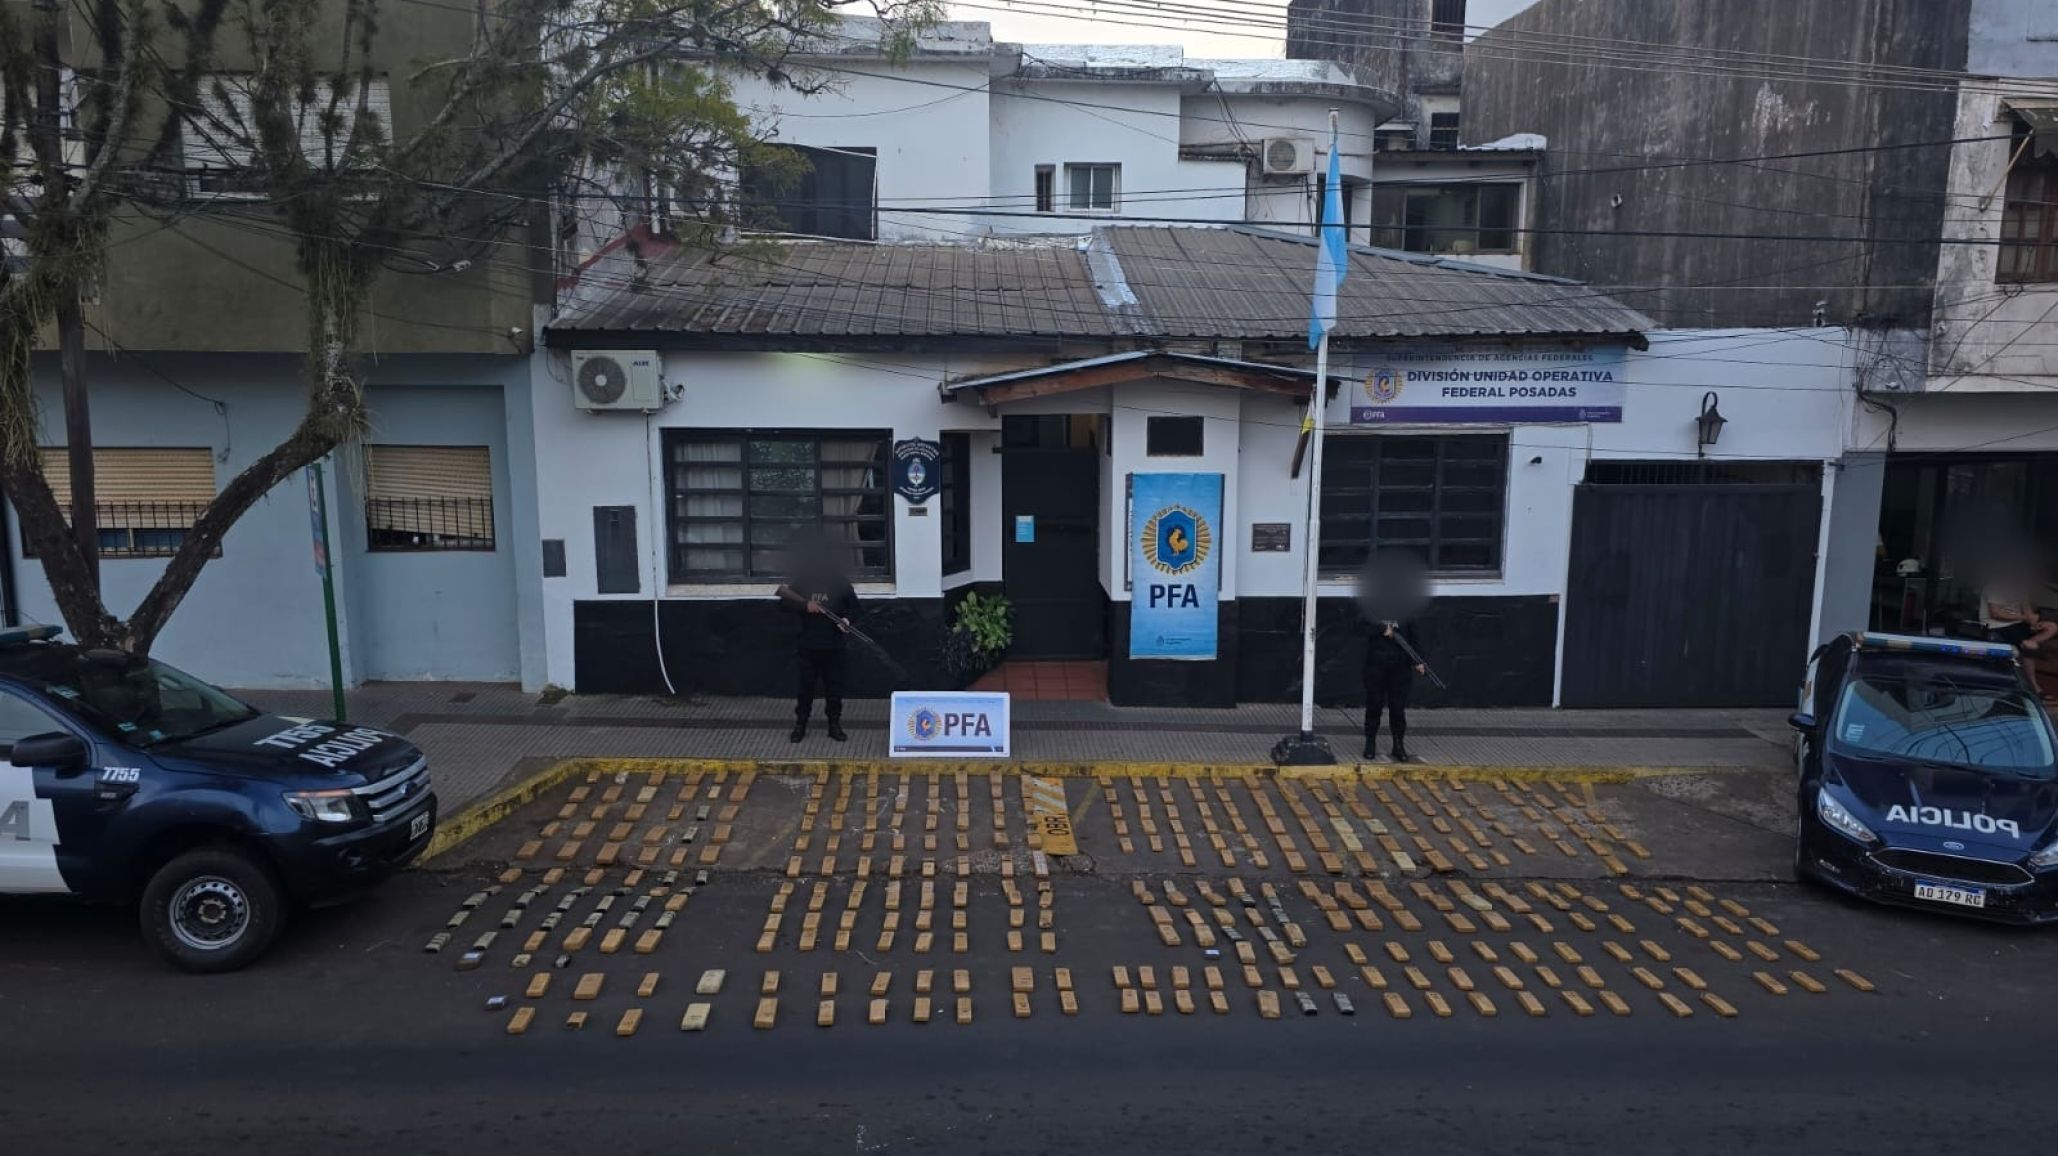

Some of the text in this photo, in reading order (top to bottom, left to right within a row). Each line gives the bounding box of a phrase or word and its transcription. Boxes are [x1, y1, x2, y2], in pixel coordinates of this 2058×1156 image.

[1407, 368, 1614, 382] DIVISIÓN UNIDAD OPERATIVA
[1442, 386, 1577, 398] FEDERAL POSADAS
[1150, 583, 1200, 608] PFA
[944, 713, 992, 736] PFA
[102, 766, 141, 781] 7755
